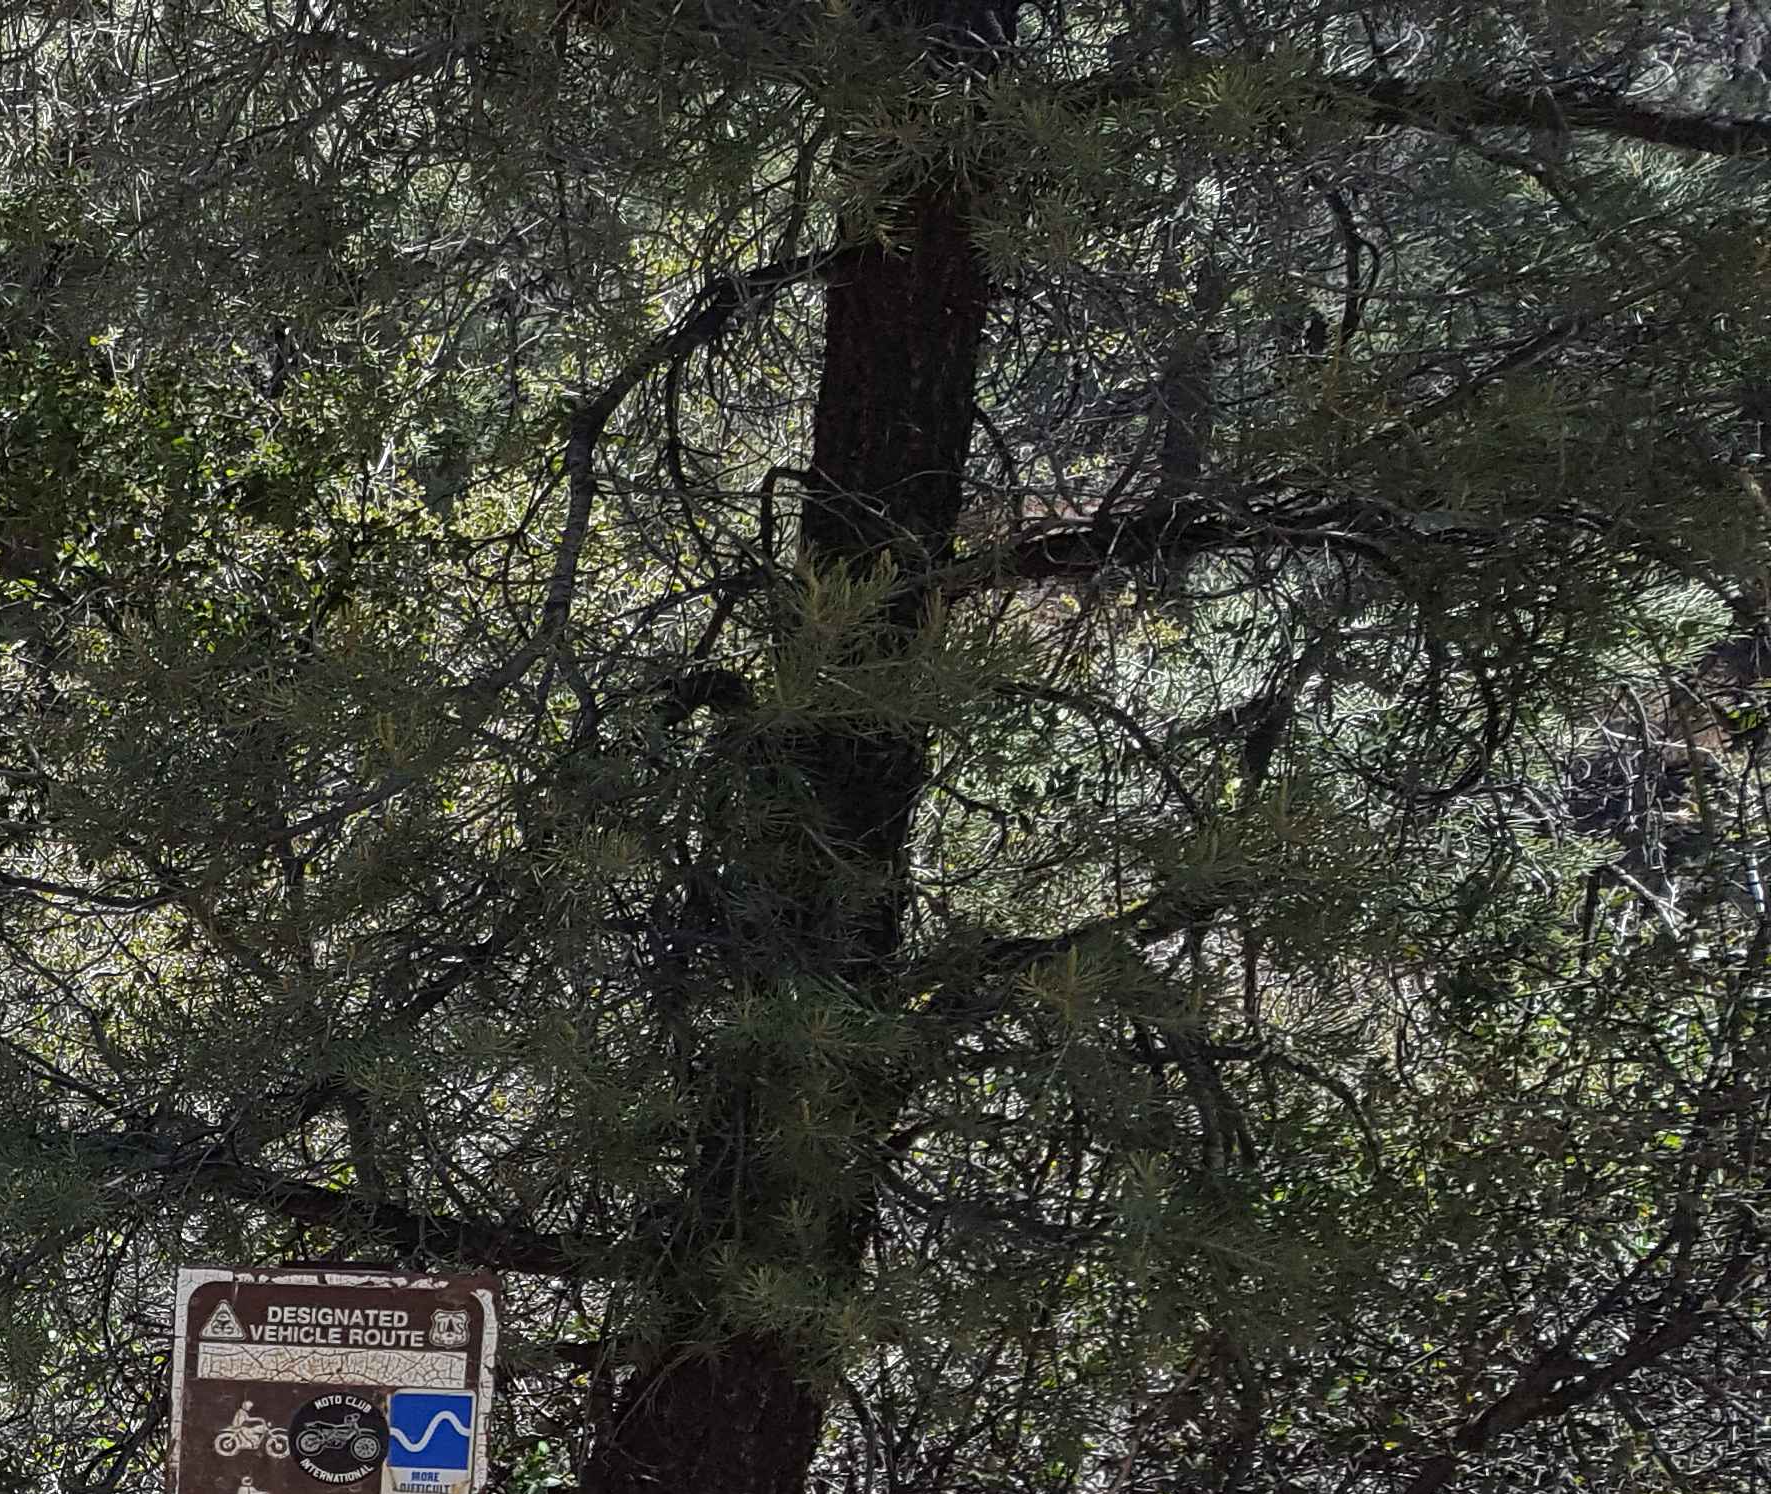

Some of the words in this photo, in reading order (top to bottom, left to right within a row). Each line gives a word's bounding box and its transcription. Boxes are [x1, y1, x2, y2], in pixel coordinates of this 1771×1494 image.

[267, 1306, 408, 1328] DESIGNATED
[249, 1324, 343, 1344] VEHICLE
[348, 1329, 425, 1347] ROUTE
[314, 1395, 342, 1410] MOTO
[345, 1396, 372, 1413] CLUB
[300, 1458, 374, 1484] INTERNATIONAL
[411, 1471, 440, 1482] MORE
[400, 1483, 450, 1494] DIFFICULT
